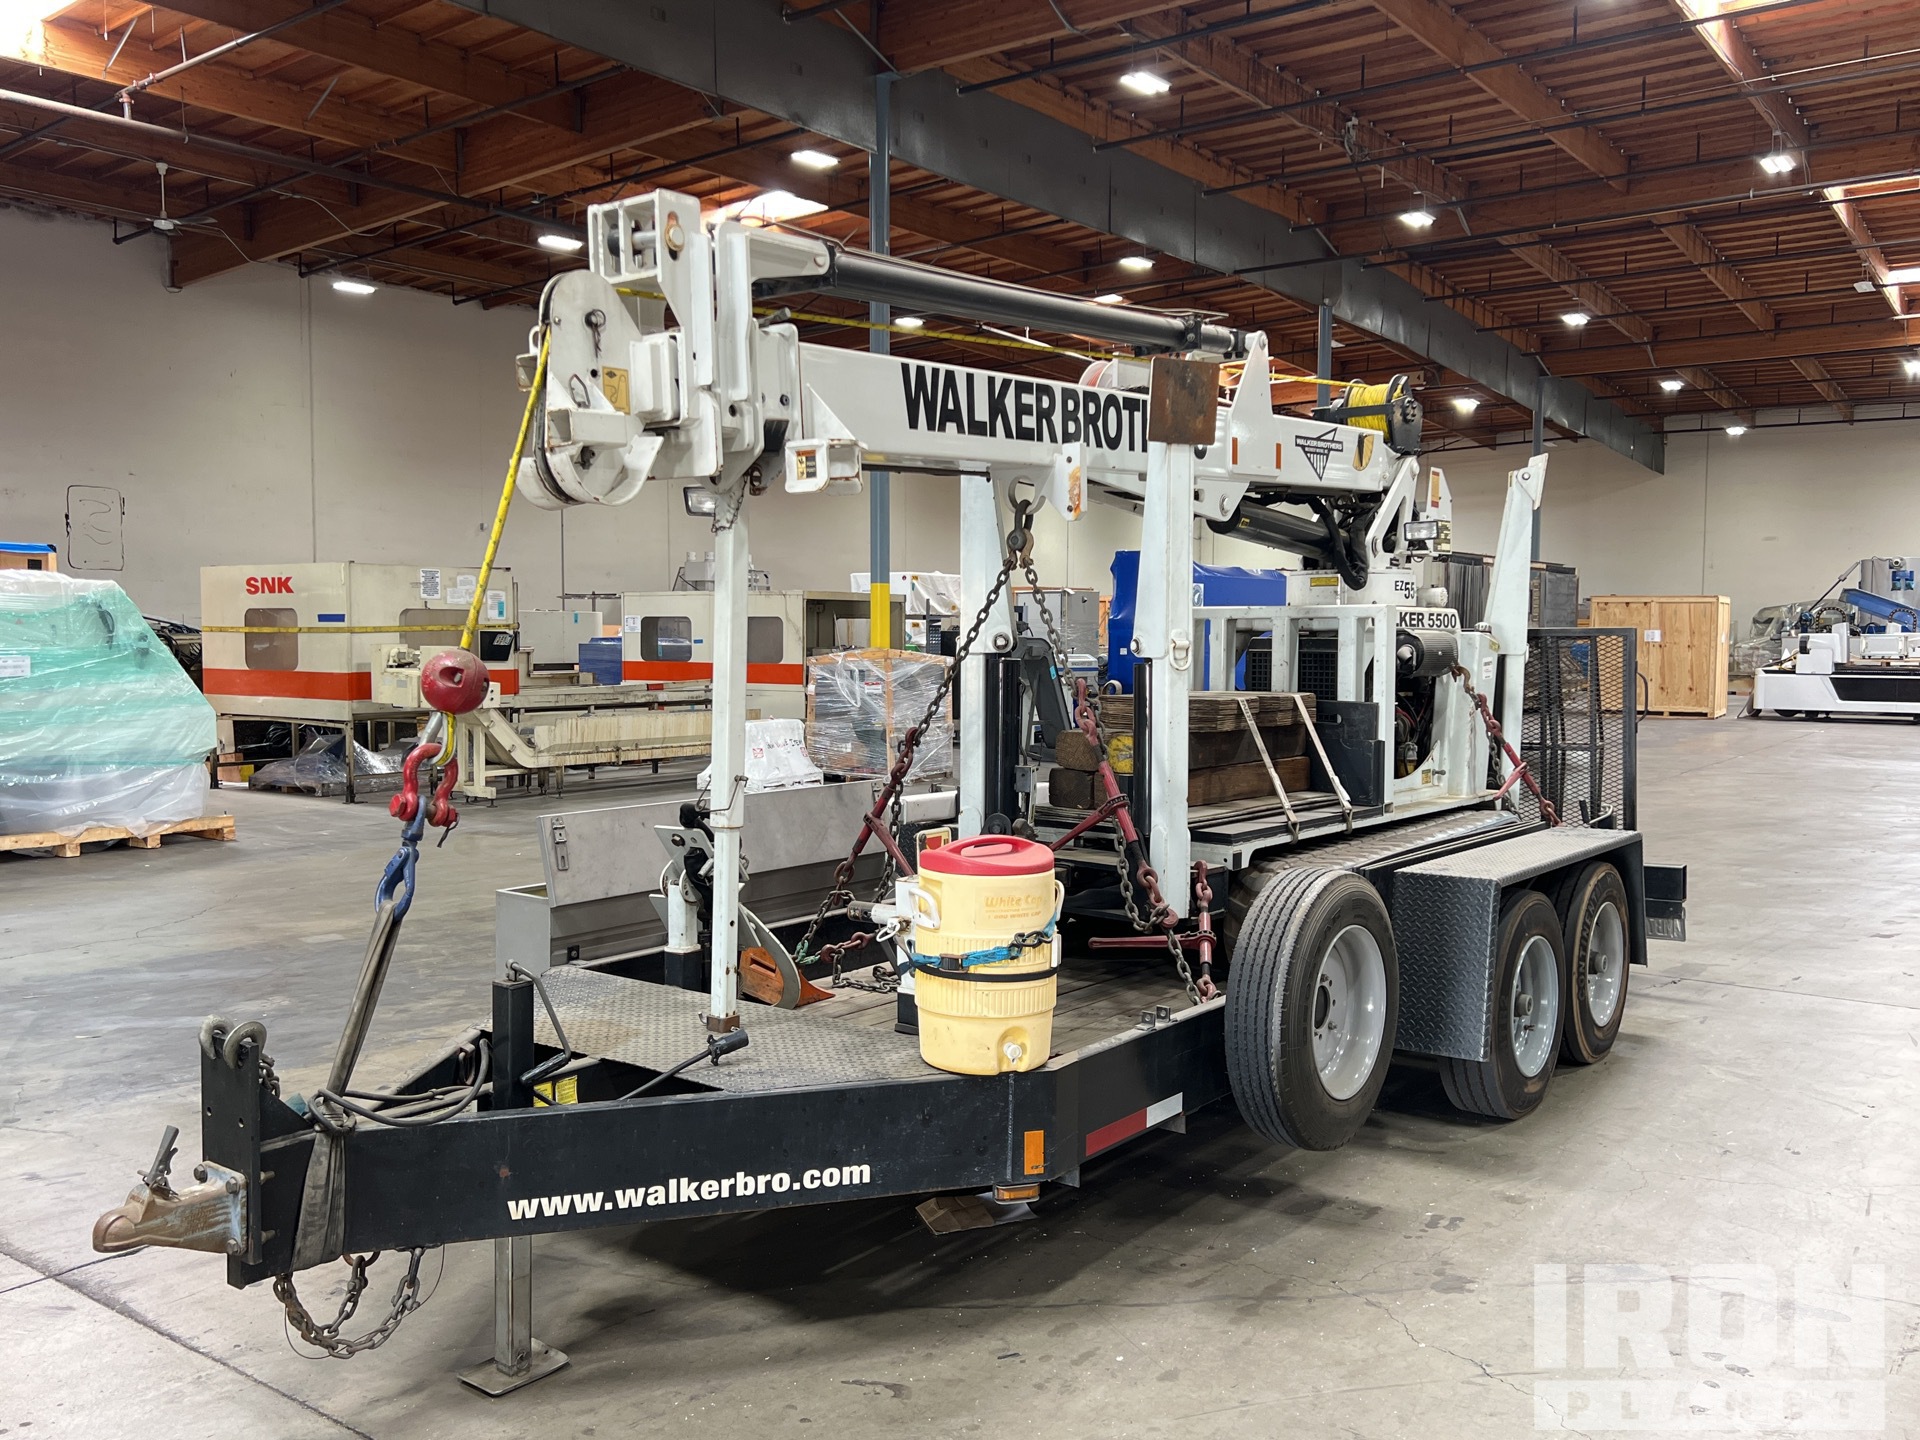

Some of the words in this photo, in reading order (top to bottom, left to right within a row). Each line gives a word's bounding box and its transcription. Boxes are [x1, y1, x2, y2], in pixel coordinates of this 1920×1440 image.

[901, 363, 1058, 444] WALKER
[1061, 386, 1148, 453] BROT
[1296, 438, 1317, 447] WALKER
[1317, 441, 1342, 450] BROTHERS
[246, 576, 294, 595] SNK
[1428, 613, 1457, 628] 5500
[985, 896, 1021, 908] White
[1024, 894, 1042, 908] Cap
[507, 1164, 871, 1220] www.walkerbro.com
